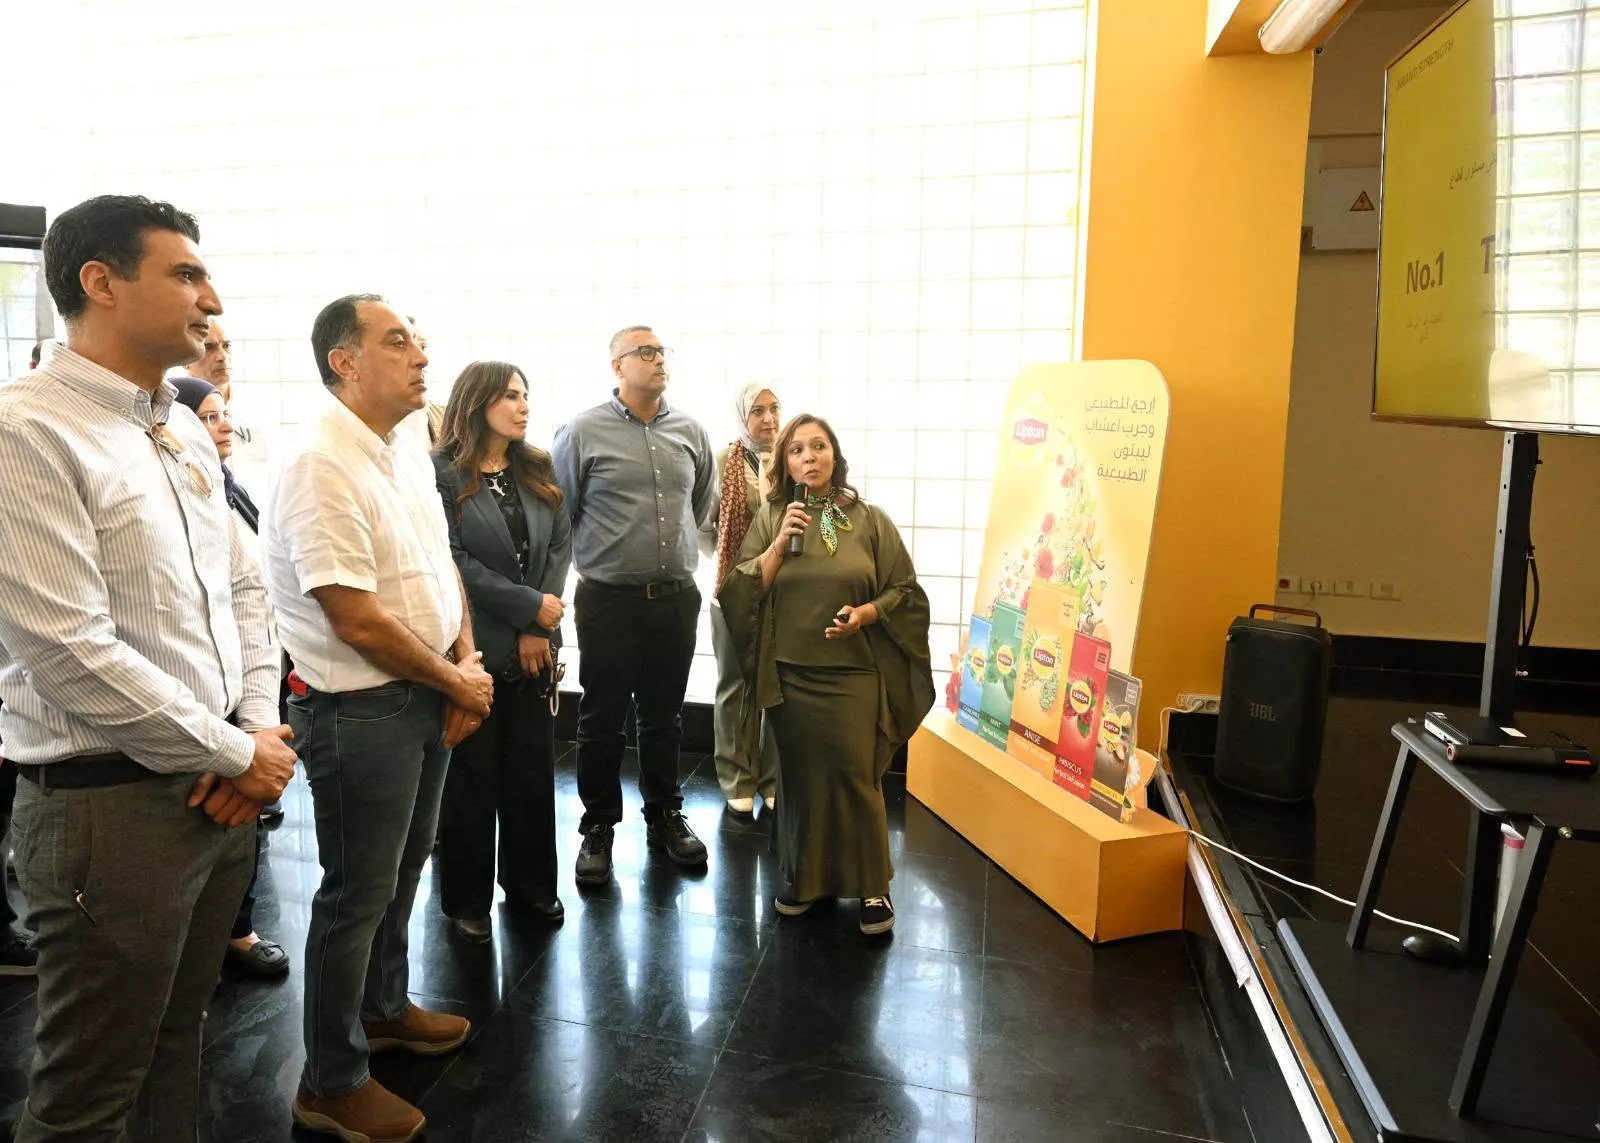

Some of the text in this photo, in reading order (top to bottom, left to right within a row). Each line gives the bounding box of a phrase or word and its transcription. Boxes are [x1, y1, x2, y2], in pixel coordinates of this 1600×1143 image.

[1406, 251, 1445, 294] No.1
[1113, 444, 1151, 462] ليبتون
[1097, 463, 1147, 483] الطبيعية
[1034, 650, 1054, 665] Lipton
[1072, 691, 1089, 704] Lipton
[1104, 722, 1119, 734] Lipton
[1024, 729, 1041, 745] ANISE
